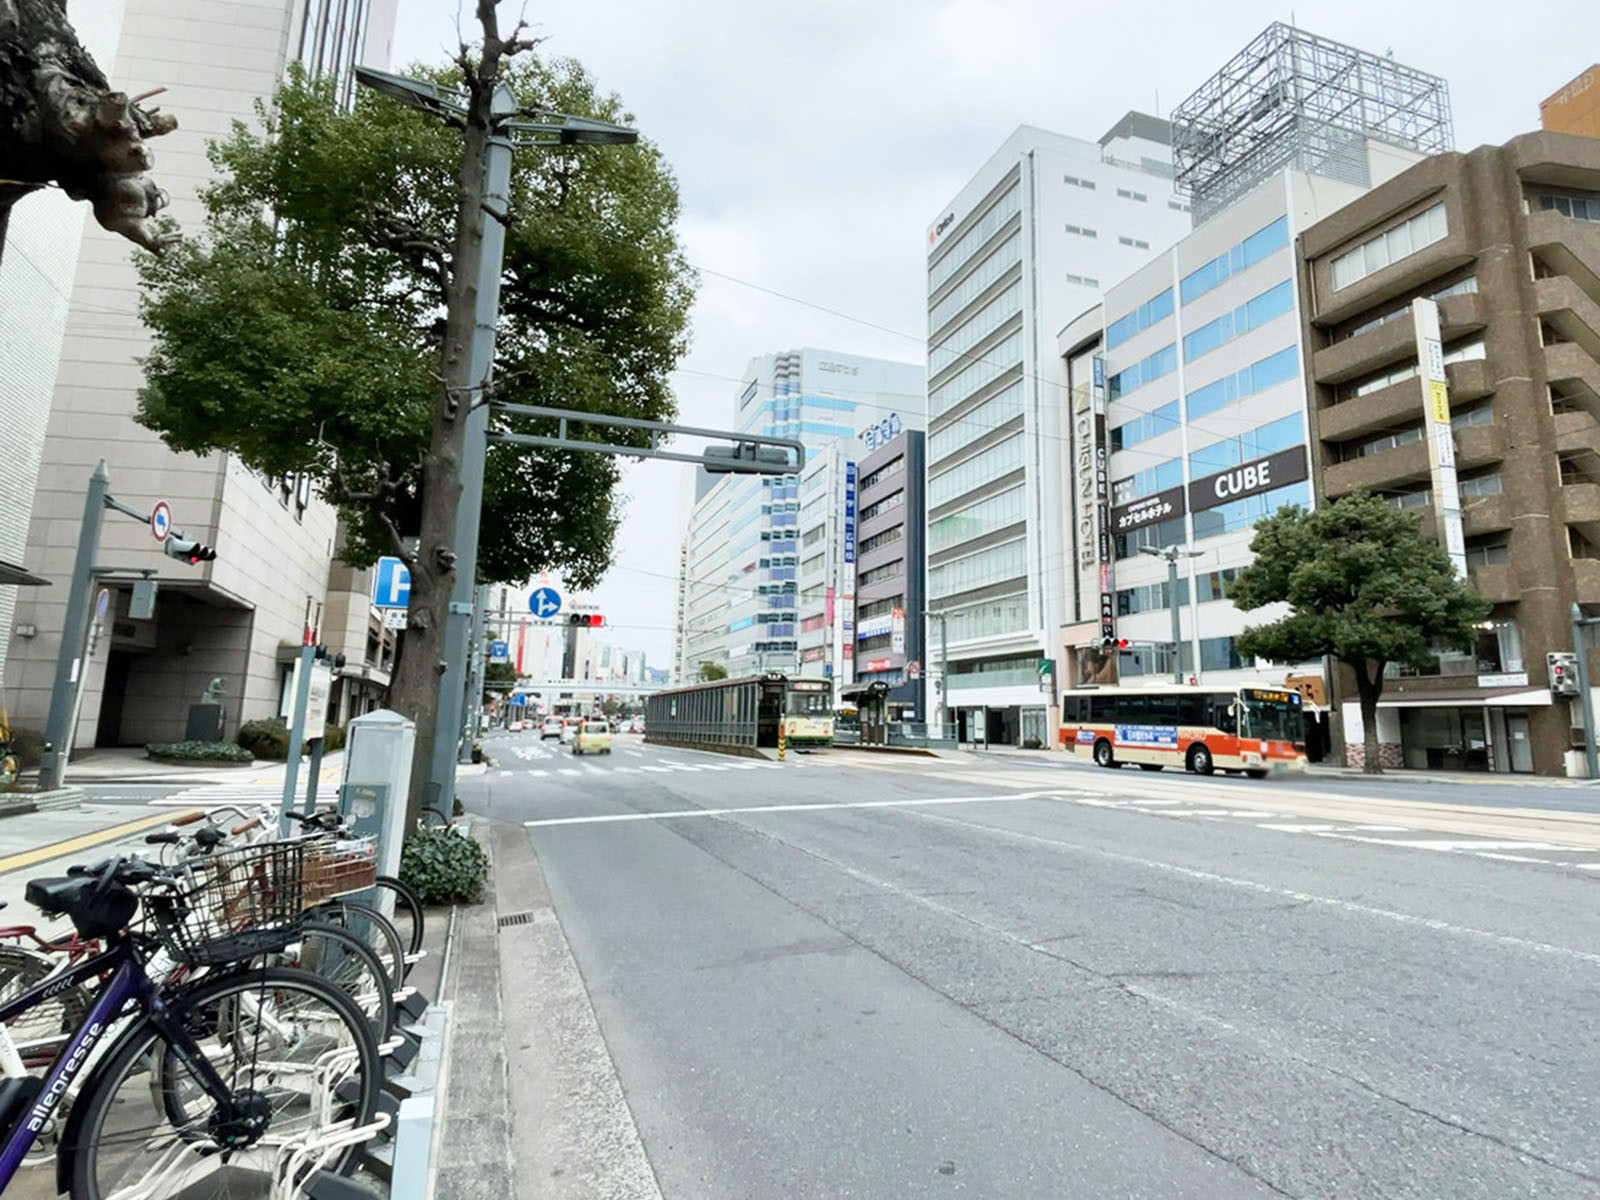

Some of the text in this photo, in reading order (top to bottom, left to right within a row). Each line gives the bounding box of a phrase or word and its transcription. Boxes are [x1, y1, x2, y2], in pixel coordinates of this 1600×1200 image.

[1097, 448, 1106, 494] CUBE
[1214, 461, 1271, 498] CUBE
[1081, 502, 1096, 571] HOTEL
[1118, 502, 1173, 529] カプセルホテル
[27, 1022, 103, 1132] allegresse
